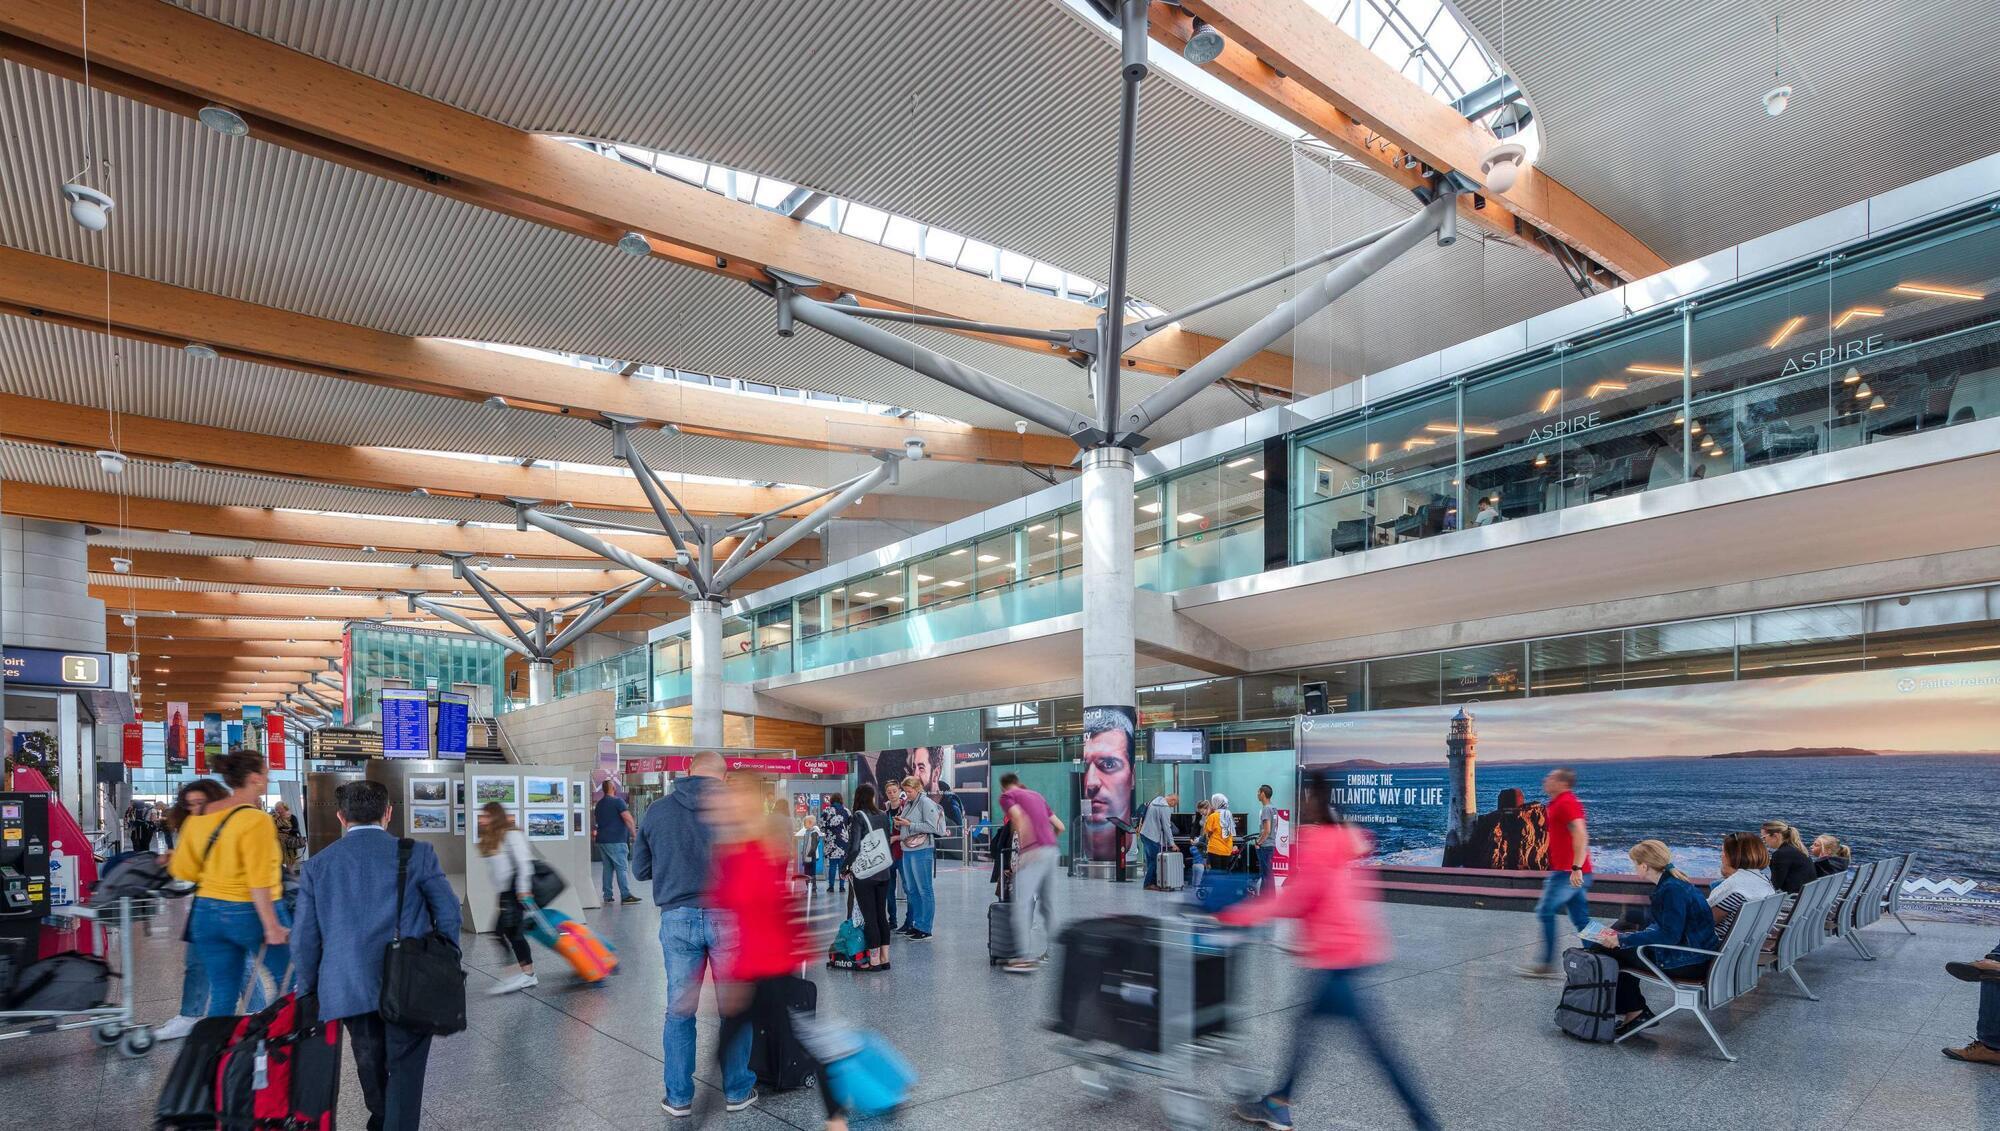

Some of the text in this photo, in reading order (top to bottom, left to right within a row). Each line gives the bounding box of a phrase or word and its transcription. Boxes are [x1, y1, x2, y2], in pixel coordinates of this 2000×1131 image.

[1780, 333, 1884, 377] ASPIRE
[1527, 411, 1600, 444] ASPIRE
[1340, 467, 1395, 493] ASPIRE
[364, 623, 440, 637] DEPARTURE GATES
[1330, 720, 1354, 728] AIRPORT
[1347, 774, 1393, 786] EMBRACE THE
[1330, 788, 1376, 804] ATLANTIC
[1379, 788, 1401, 804] WAY
[1404, 788, 1417, 805] OF
[1420, 787, 1443, 805] LIFE
